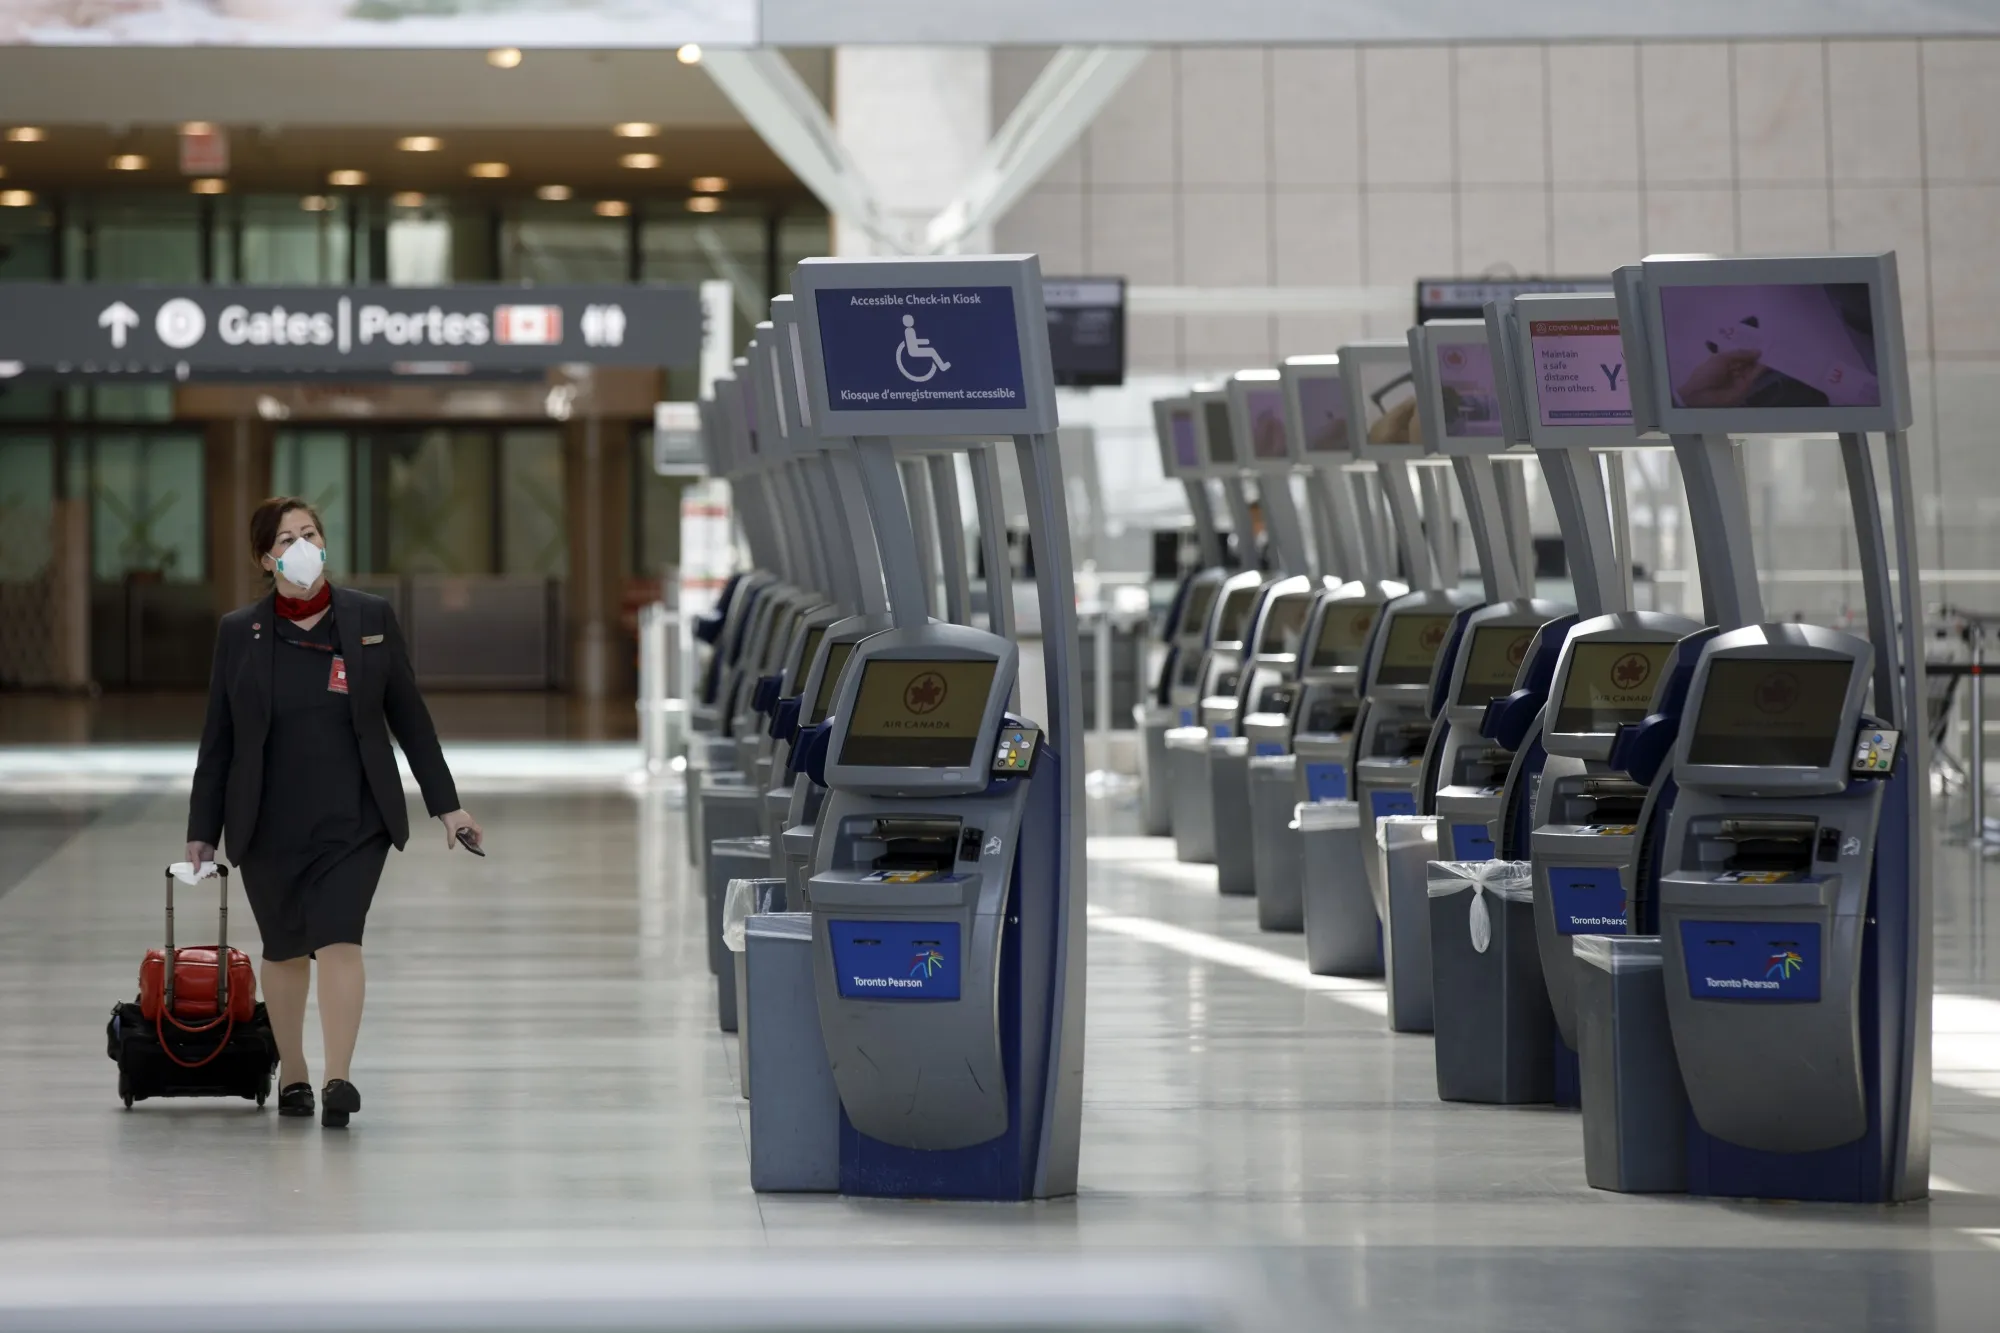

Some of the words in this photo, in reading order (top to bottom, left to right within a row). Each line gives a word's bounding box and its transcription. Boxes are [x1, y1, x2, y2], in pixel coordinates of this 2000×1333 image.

[850, 295, 903, 306] Accessible
[905, 293, 950, 305] Check-in
[953, 293, 981, 304] Kiosk
[218, 304, 334, 345] Gates
[359, 304, 490, 345] Portes
[1541, 350, 1579, 359] Maintain
[1549, 361, 1567, 370] safe
[1544, 372, 1579, 381] distance
[1546, 384, 1566, 392] from
[1568, 384, 1597, 393] others.
[841, 390, 880, 403] Kiosque
[881, 388, 964, 402] d'enregistrement
[966, 387, 1016, 399] accessible
[882, 720, 902, 729] AIR
[904, 720, 950, 729] CANADA
[1570, 916, 1601, 925] Toronto
[853, 976, 887, 987] Toronto
[888, 977, 923, 988] Pearson
[1705, 977, 1741, 988] Toronto
[1742, 978, 1780, 989] Pearson
